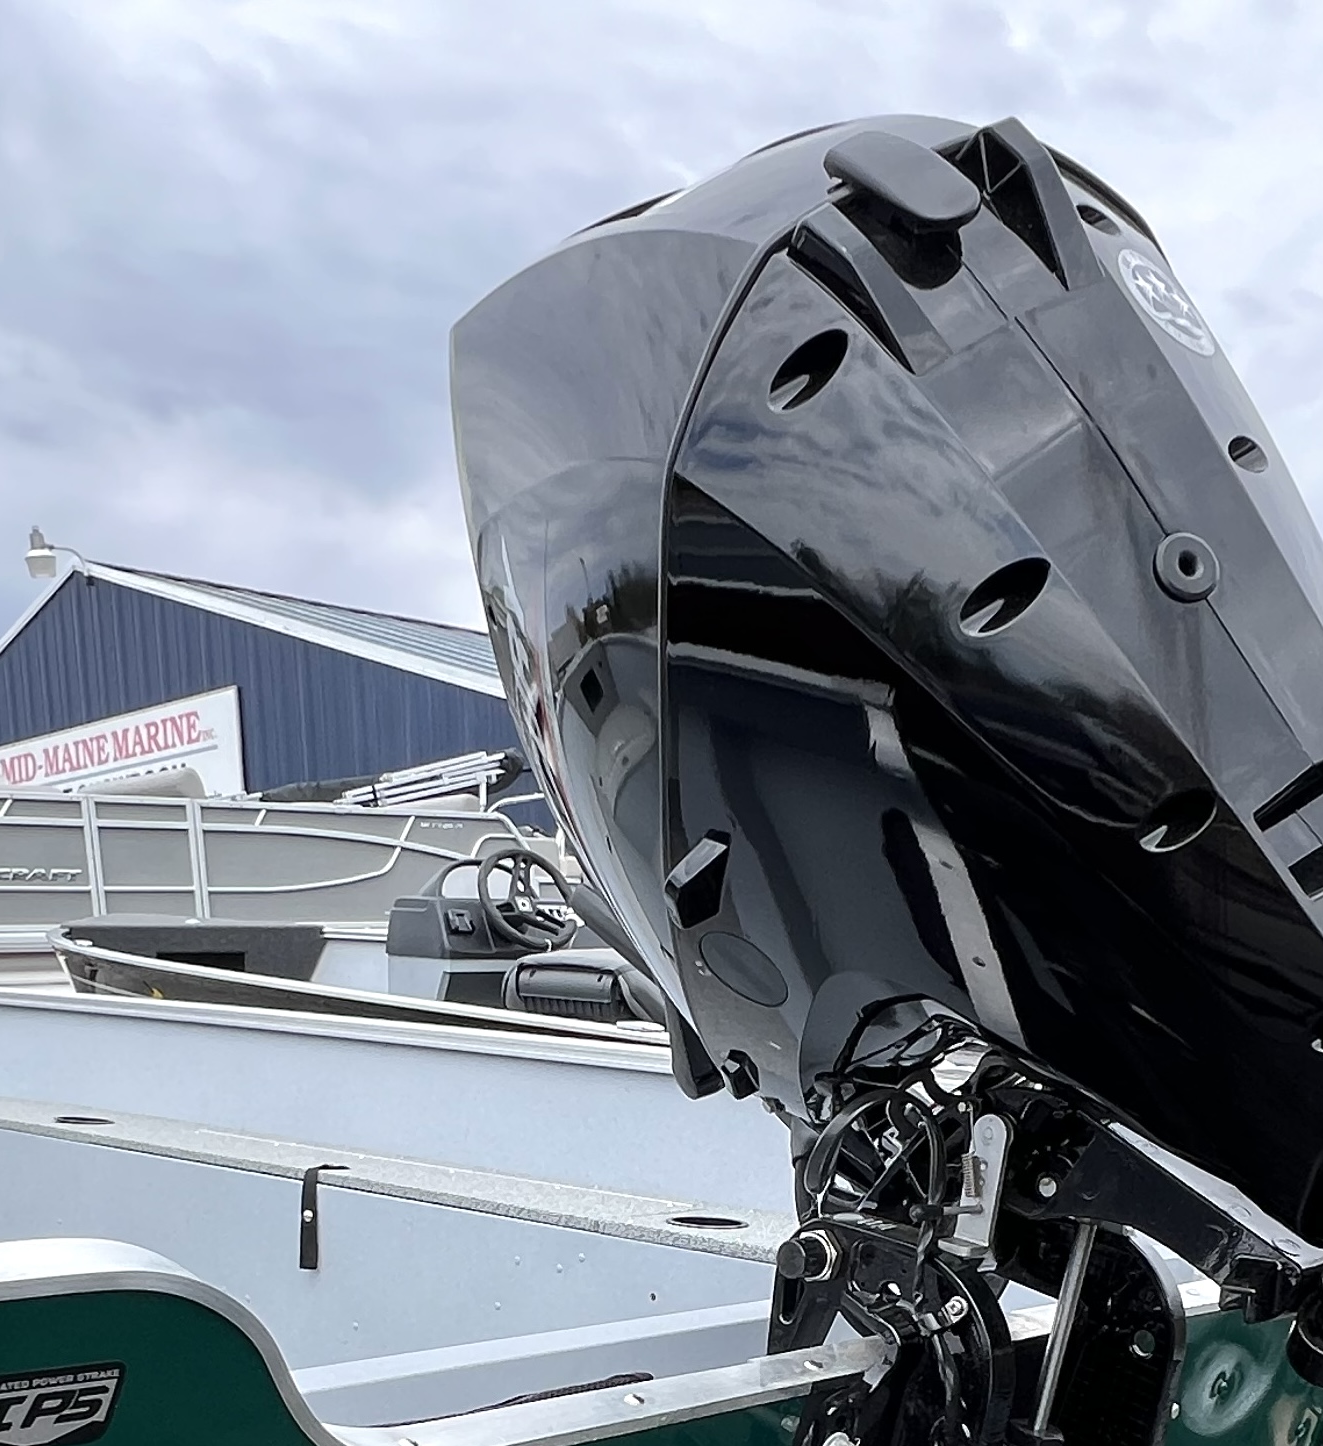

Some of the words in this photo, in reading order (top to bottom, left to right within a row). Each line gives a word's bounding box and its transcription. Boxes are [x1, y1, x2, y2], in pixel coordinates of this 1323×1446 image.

[0, 735, 111, 785] MID-MAINE
[112, 710, 202, 760] MARINE
[31, 1373, 75, 1388] POWER
[76, 1368, 121, 1382] STRAKE
